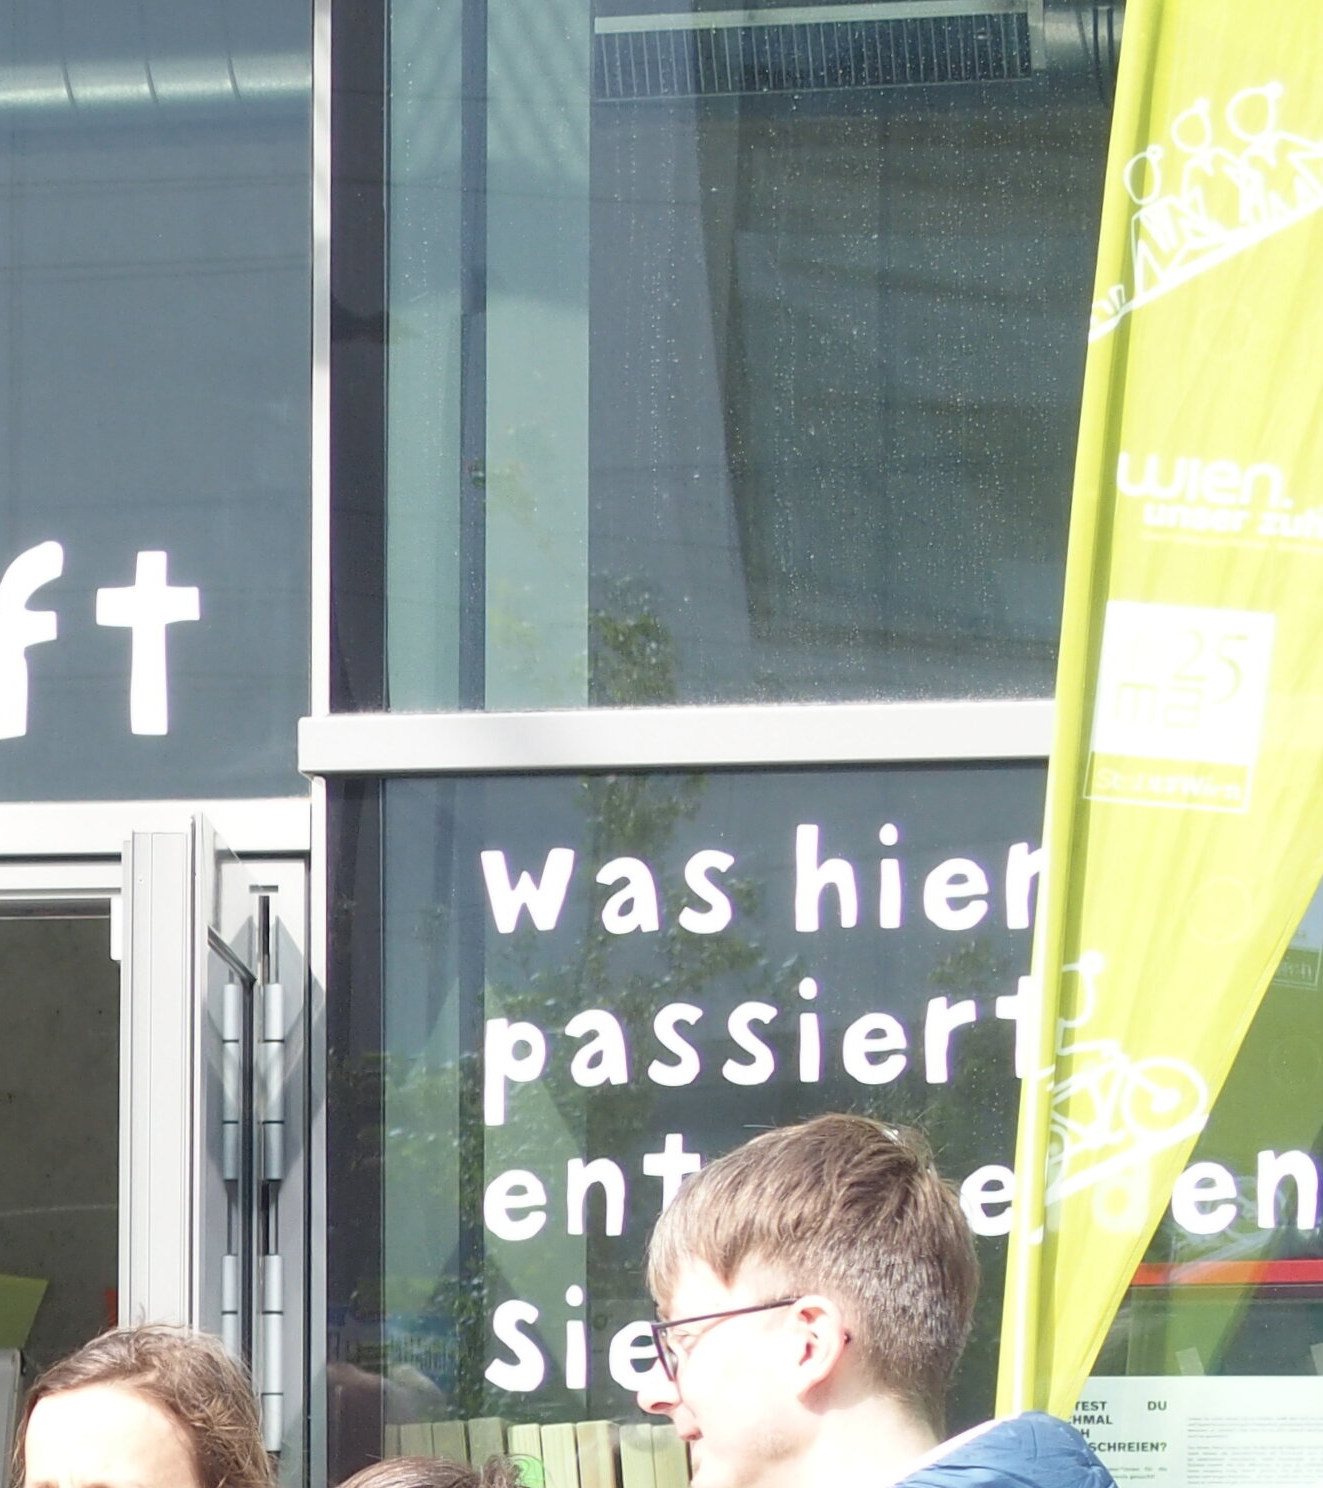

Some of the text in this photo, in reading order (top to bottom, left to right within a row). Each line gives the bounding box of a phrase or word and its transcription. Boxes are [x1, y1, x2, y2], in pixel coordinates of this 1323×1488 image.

[481, 847, 734, 935] was
[482, 976, 1037, 1126] passiert
[484, 1284, 661, 1392] Sie
[1147, 1400, 1168, 1412] DU
